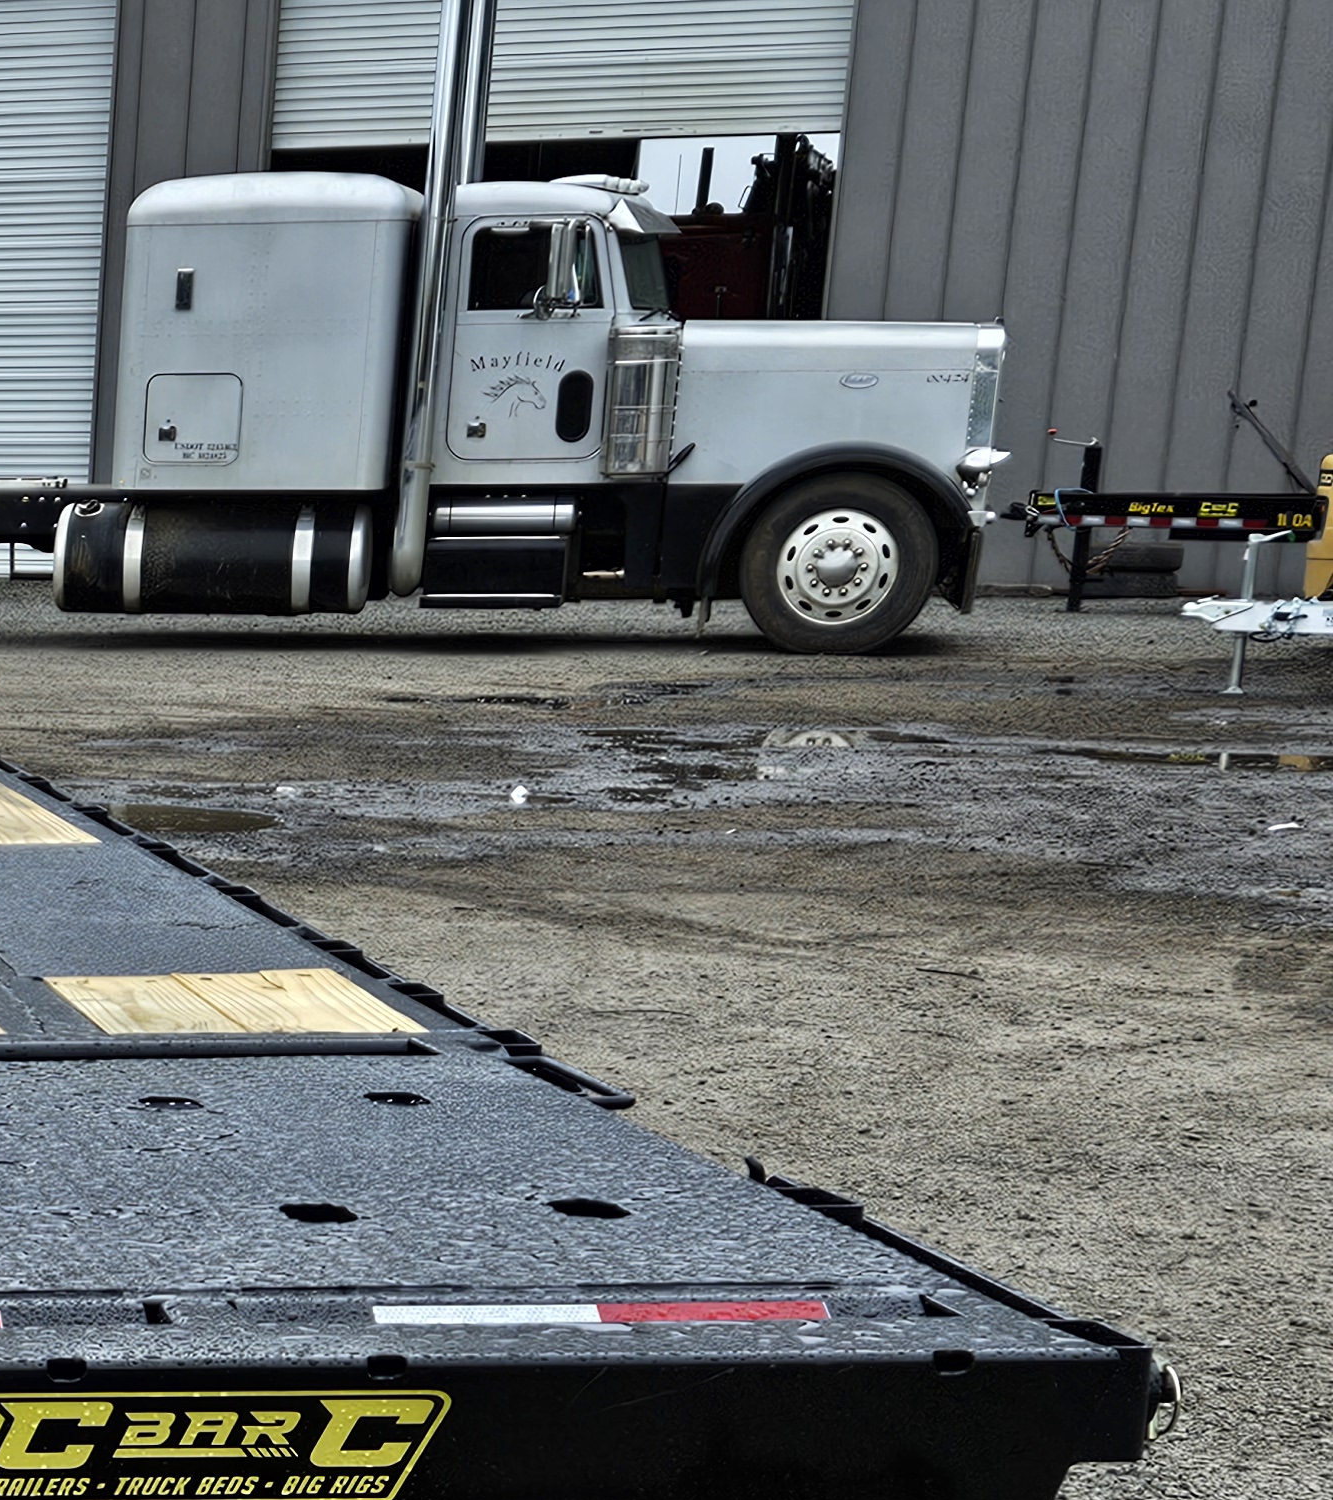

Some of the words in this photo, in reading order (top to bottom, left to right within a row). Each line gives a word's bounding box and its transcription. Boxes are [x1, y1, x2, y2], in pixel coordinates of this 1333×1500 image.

[470, 351, 566, 372] Mayfield
[1128, 502, 1175, 515] BigTex
[119, 1411, 302, 1446] BAR
[309, 1399, 435, 1467] C
[114, 1476, 191, 1496] TRUCK
[196, 1476, 256, 1496] BEDS
[282, 1475, 331, 1495] BIG
[329, 1475, 390, 1494] RIGS
